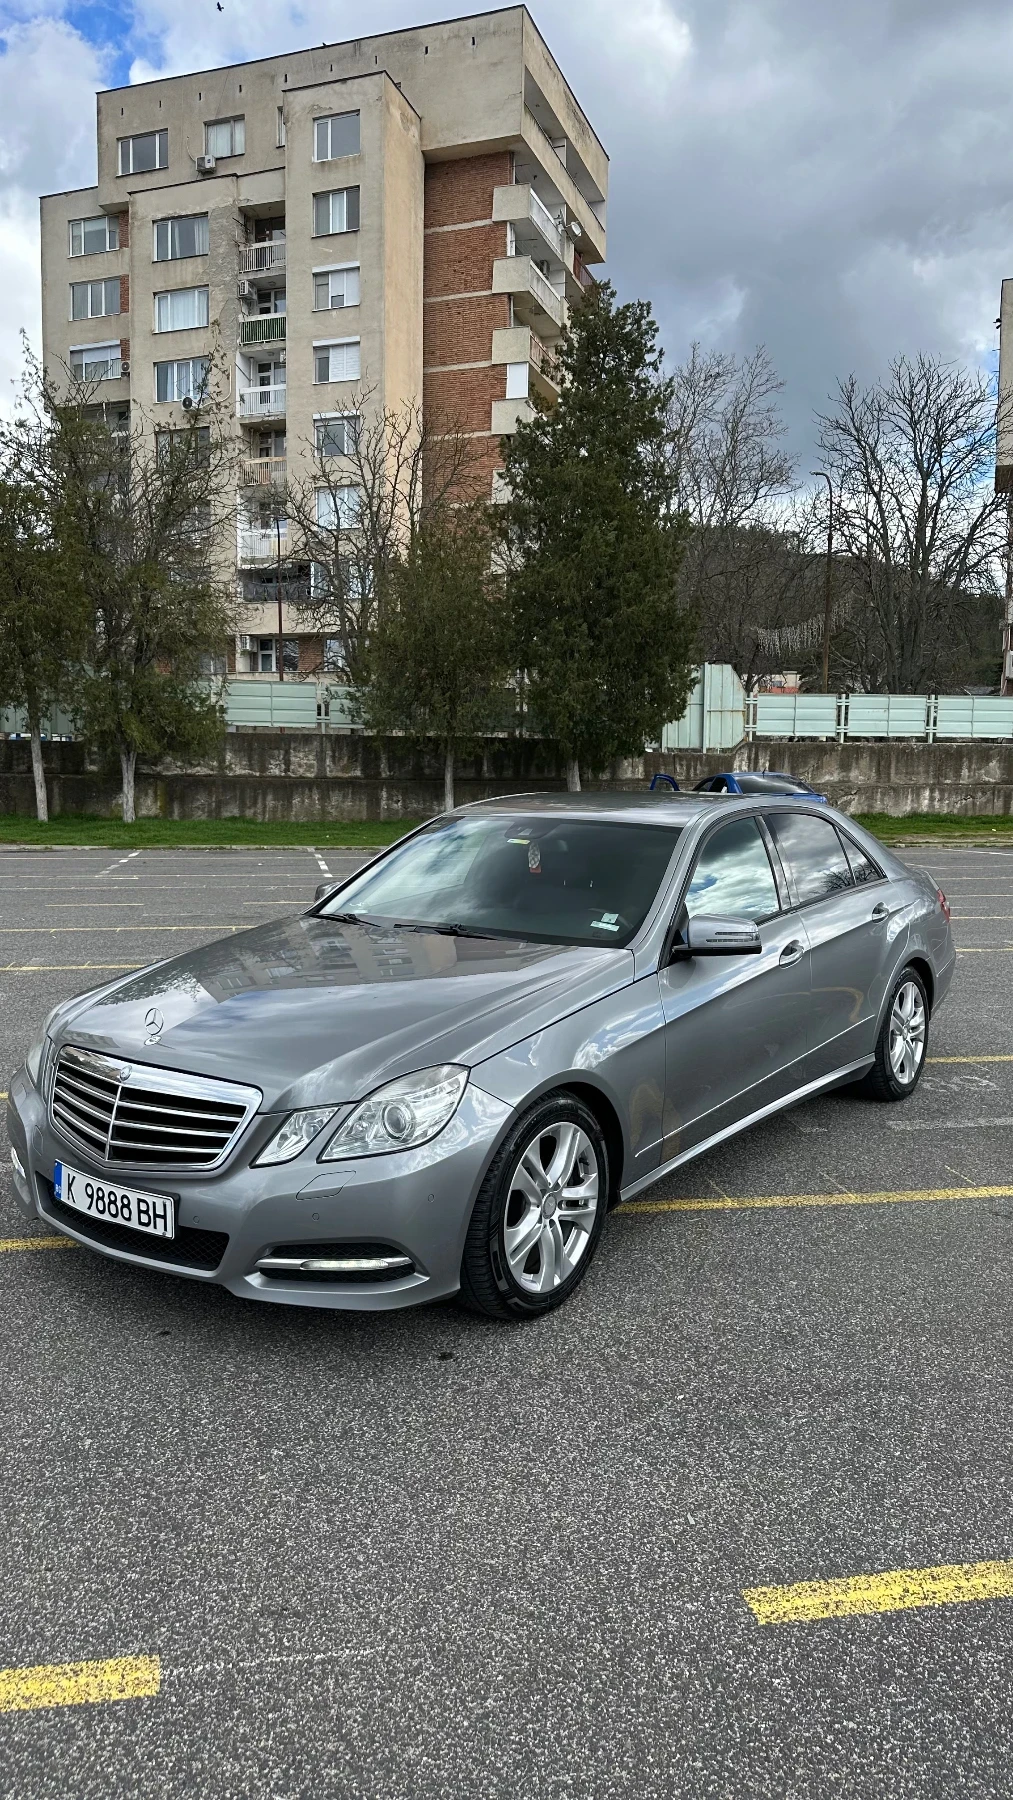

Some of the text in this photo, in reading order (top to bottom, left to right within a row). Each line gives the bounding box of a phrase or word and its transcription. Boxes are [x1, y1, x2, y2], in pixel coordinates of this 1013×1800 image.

[67, 1172, 168, 1232] K 9888 BH
